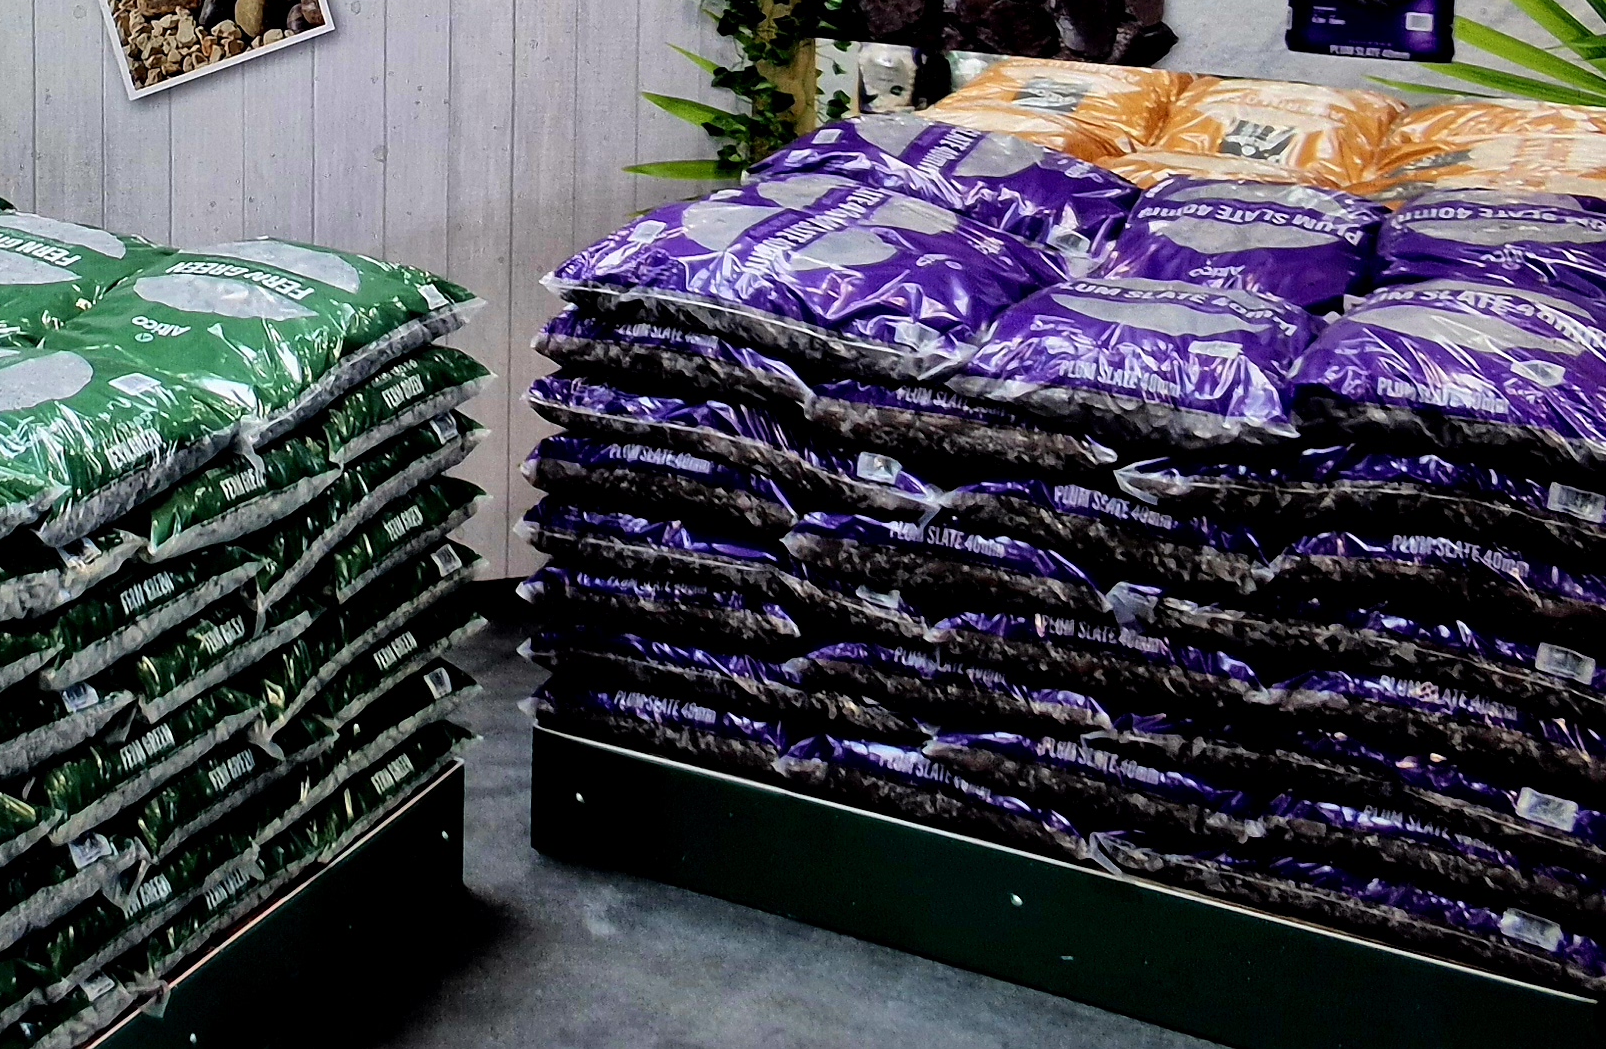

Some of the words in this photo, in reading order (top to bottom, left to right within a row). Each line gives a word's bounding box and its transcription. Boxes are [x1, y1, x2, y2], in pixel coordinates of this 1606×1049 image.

[1138, 202, 1215, 219] 40mm
[1214, 203, 1291, 227] SLATE
[1290, 216, 1363, 246] PLUM
[20, 239, 82, 268] FERN
[165, 259, 250, 281] GREEN
[242, 268, 315, 301] FERN
[132, 315, 191, 338] Altico
